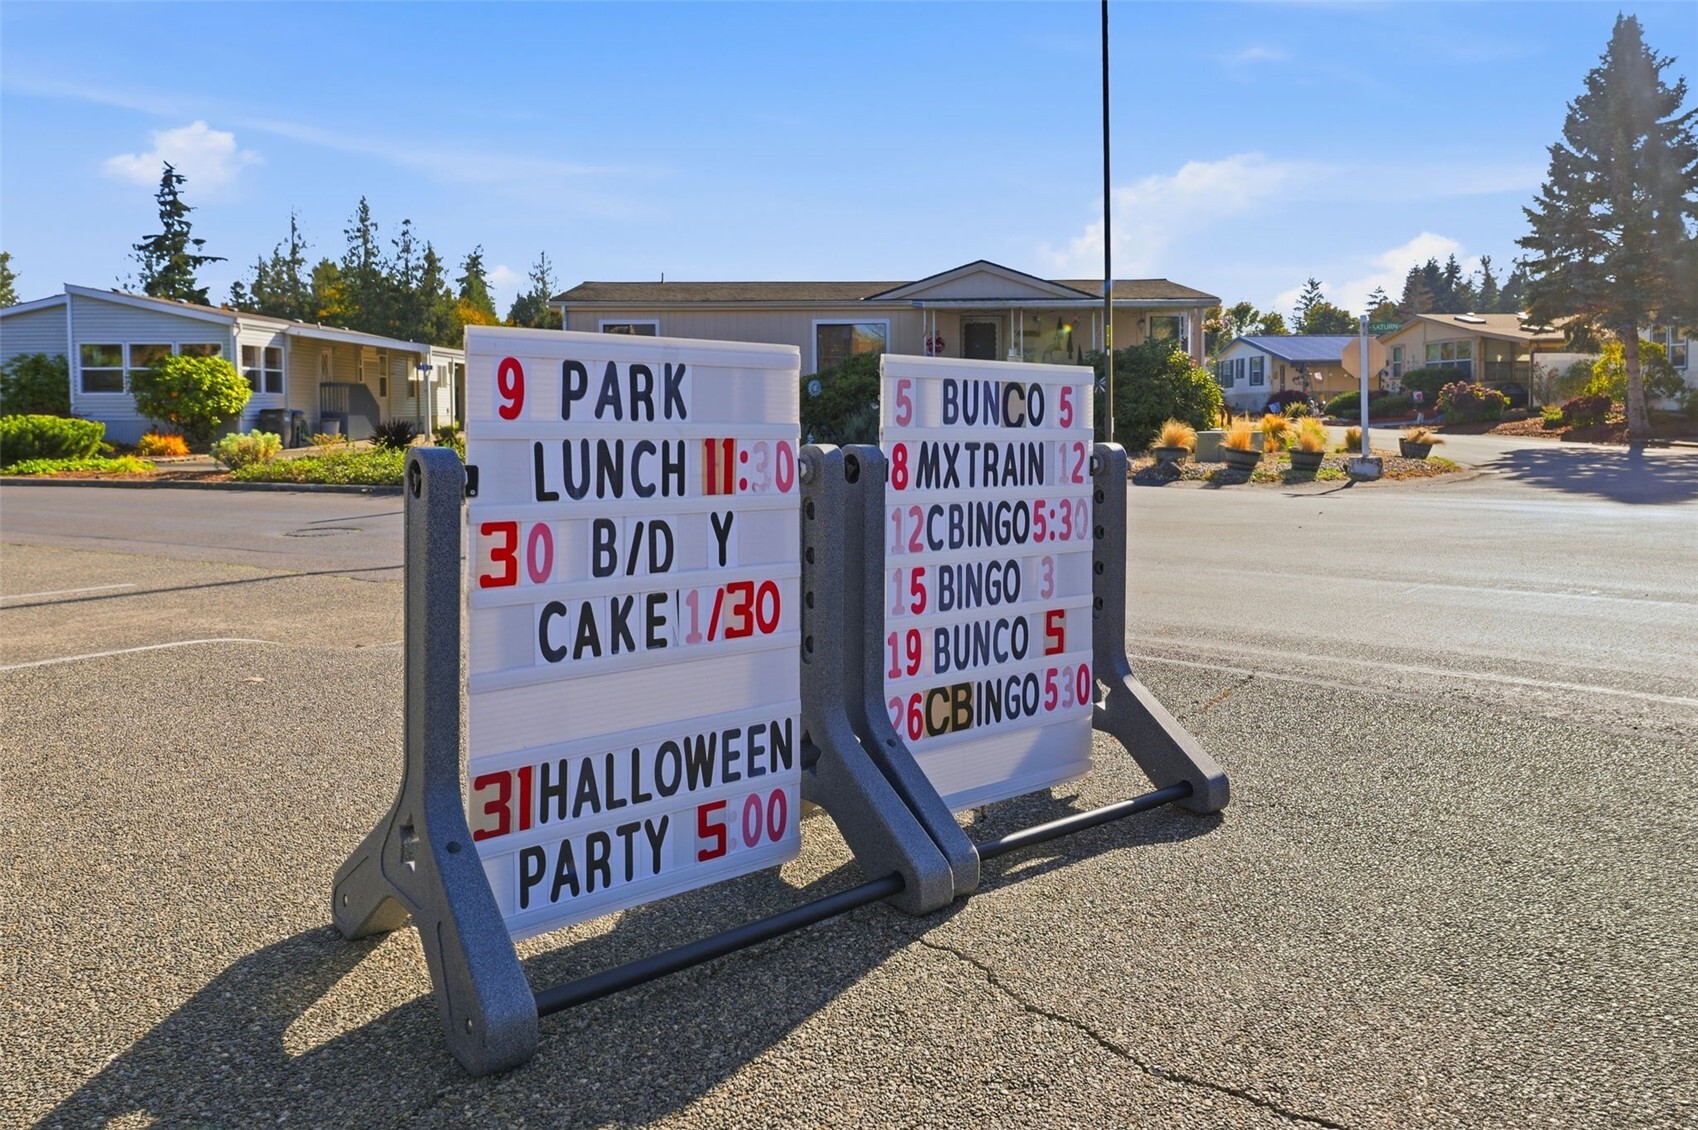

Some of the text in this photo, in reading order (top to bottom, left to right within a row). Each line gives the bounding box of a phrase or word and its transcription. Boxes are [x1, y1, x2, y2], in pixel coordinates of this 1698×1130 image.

[497, 356, 687, 422] 9 PARK
[895, 378, 1073, 428] 5 BUNCO 5
[533, 438, 795, 502] LUNCH 11:30
[891, 441, 1085, 490] 8 MXTRAIN 12
[479, 510, 734, 588] 30 B/D Y
[891, 498, 1089, 554] 12 CBINGO 5:30
[892, 555, 1055, 616] 15 BINGO 3
[538, 580, 781, 663] CAKE 1/30
[887, 609, 1065, 679] 19 BUNCO 5
[925, 672, 1040, 738] CBINGO
[1044, 663, 1091, 712] 530
[473, 717, 793, 842] 31 HALLOWEEN
[519, 815, 669, 909] PARTY
